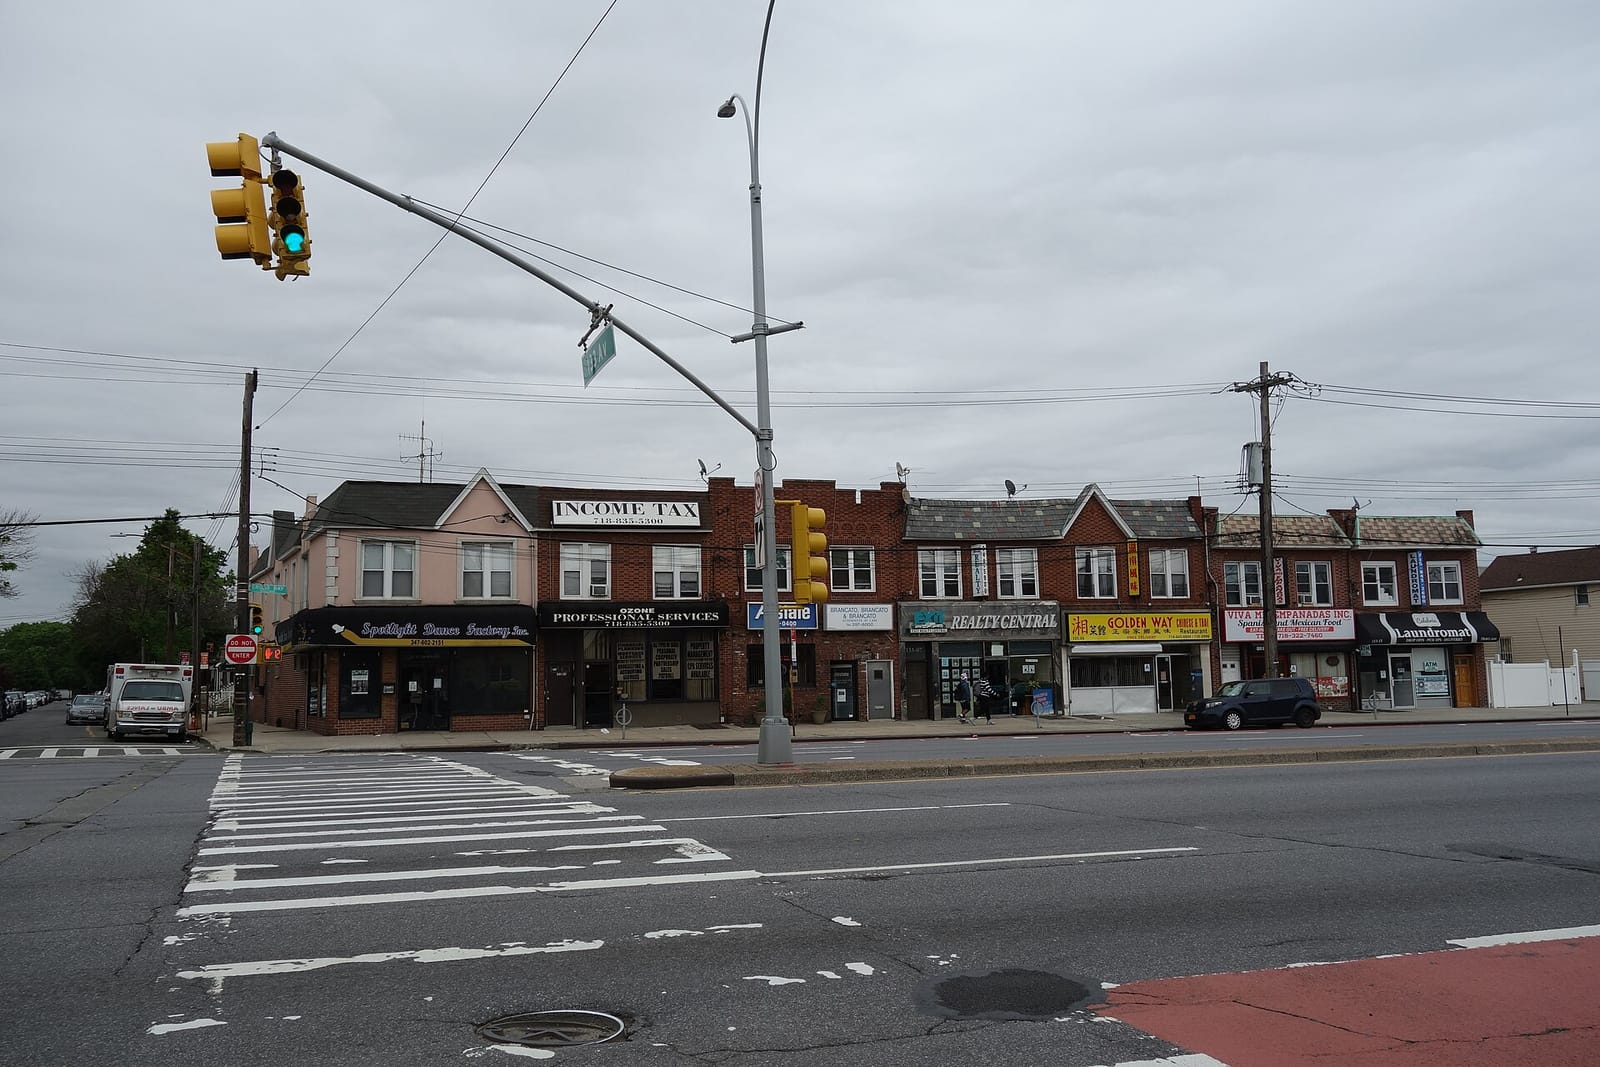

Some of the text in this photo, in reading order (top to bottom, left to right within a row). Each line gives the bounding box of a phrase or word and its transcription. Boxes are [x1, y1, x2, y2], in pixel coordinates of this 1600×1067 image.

[555, 502, 698, 518] INCOME TAX
[594, 517, 663, 525] 718-835-5300
[1409, 554, 1419, 603] LAUNDROMAT
[553, 612, 719, 622] PROFESSIONAL SERVICES
[1228, 611, 1251, 619] VIVA
[1334, 611, 1352, 619] INC.
[950, 614, 999, 630] REALTY
[1000, 614, 1058, 629] CENTRAL
[1108, 617, 1147, 629] GOLDEN
[1151, 617, 1173, 628] WAY
[361, 622, 529, 638] Spotlight Dance Factory Inc.
[1395, 628, 1472, 638] Laundromat
